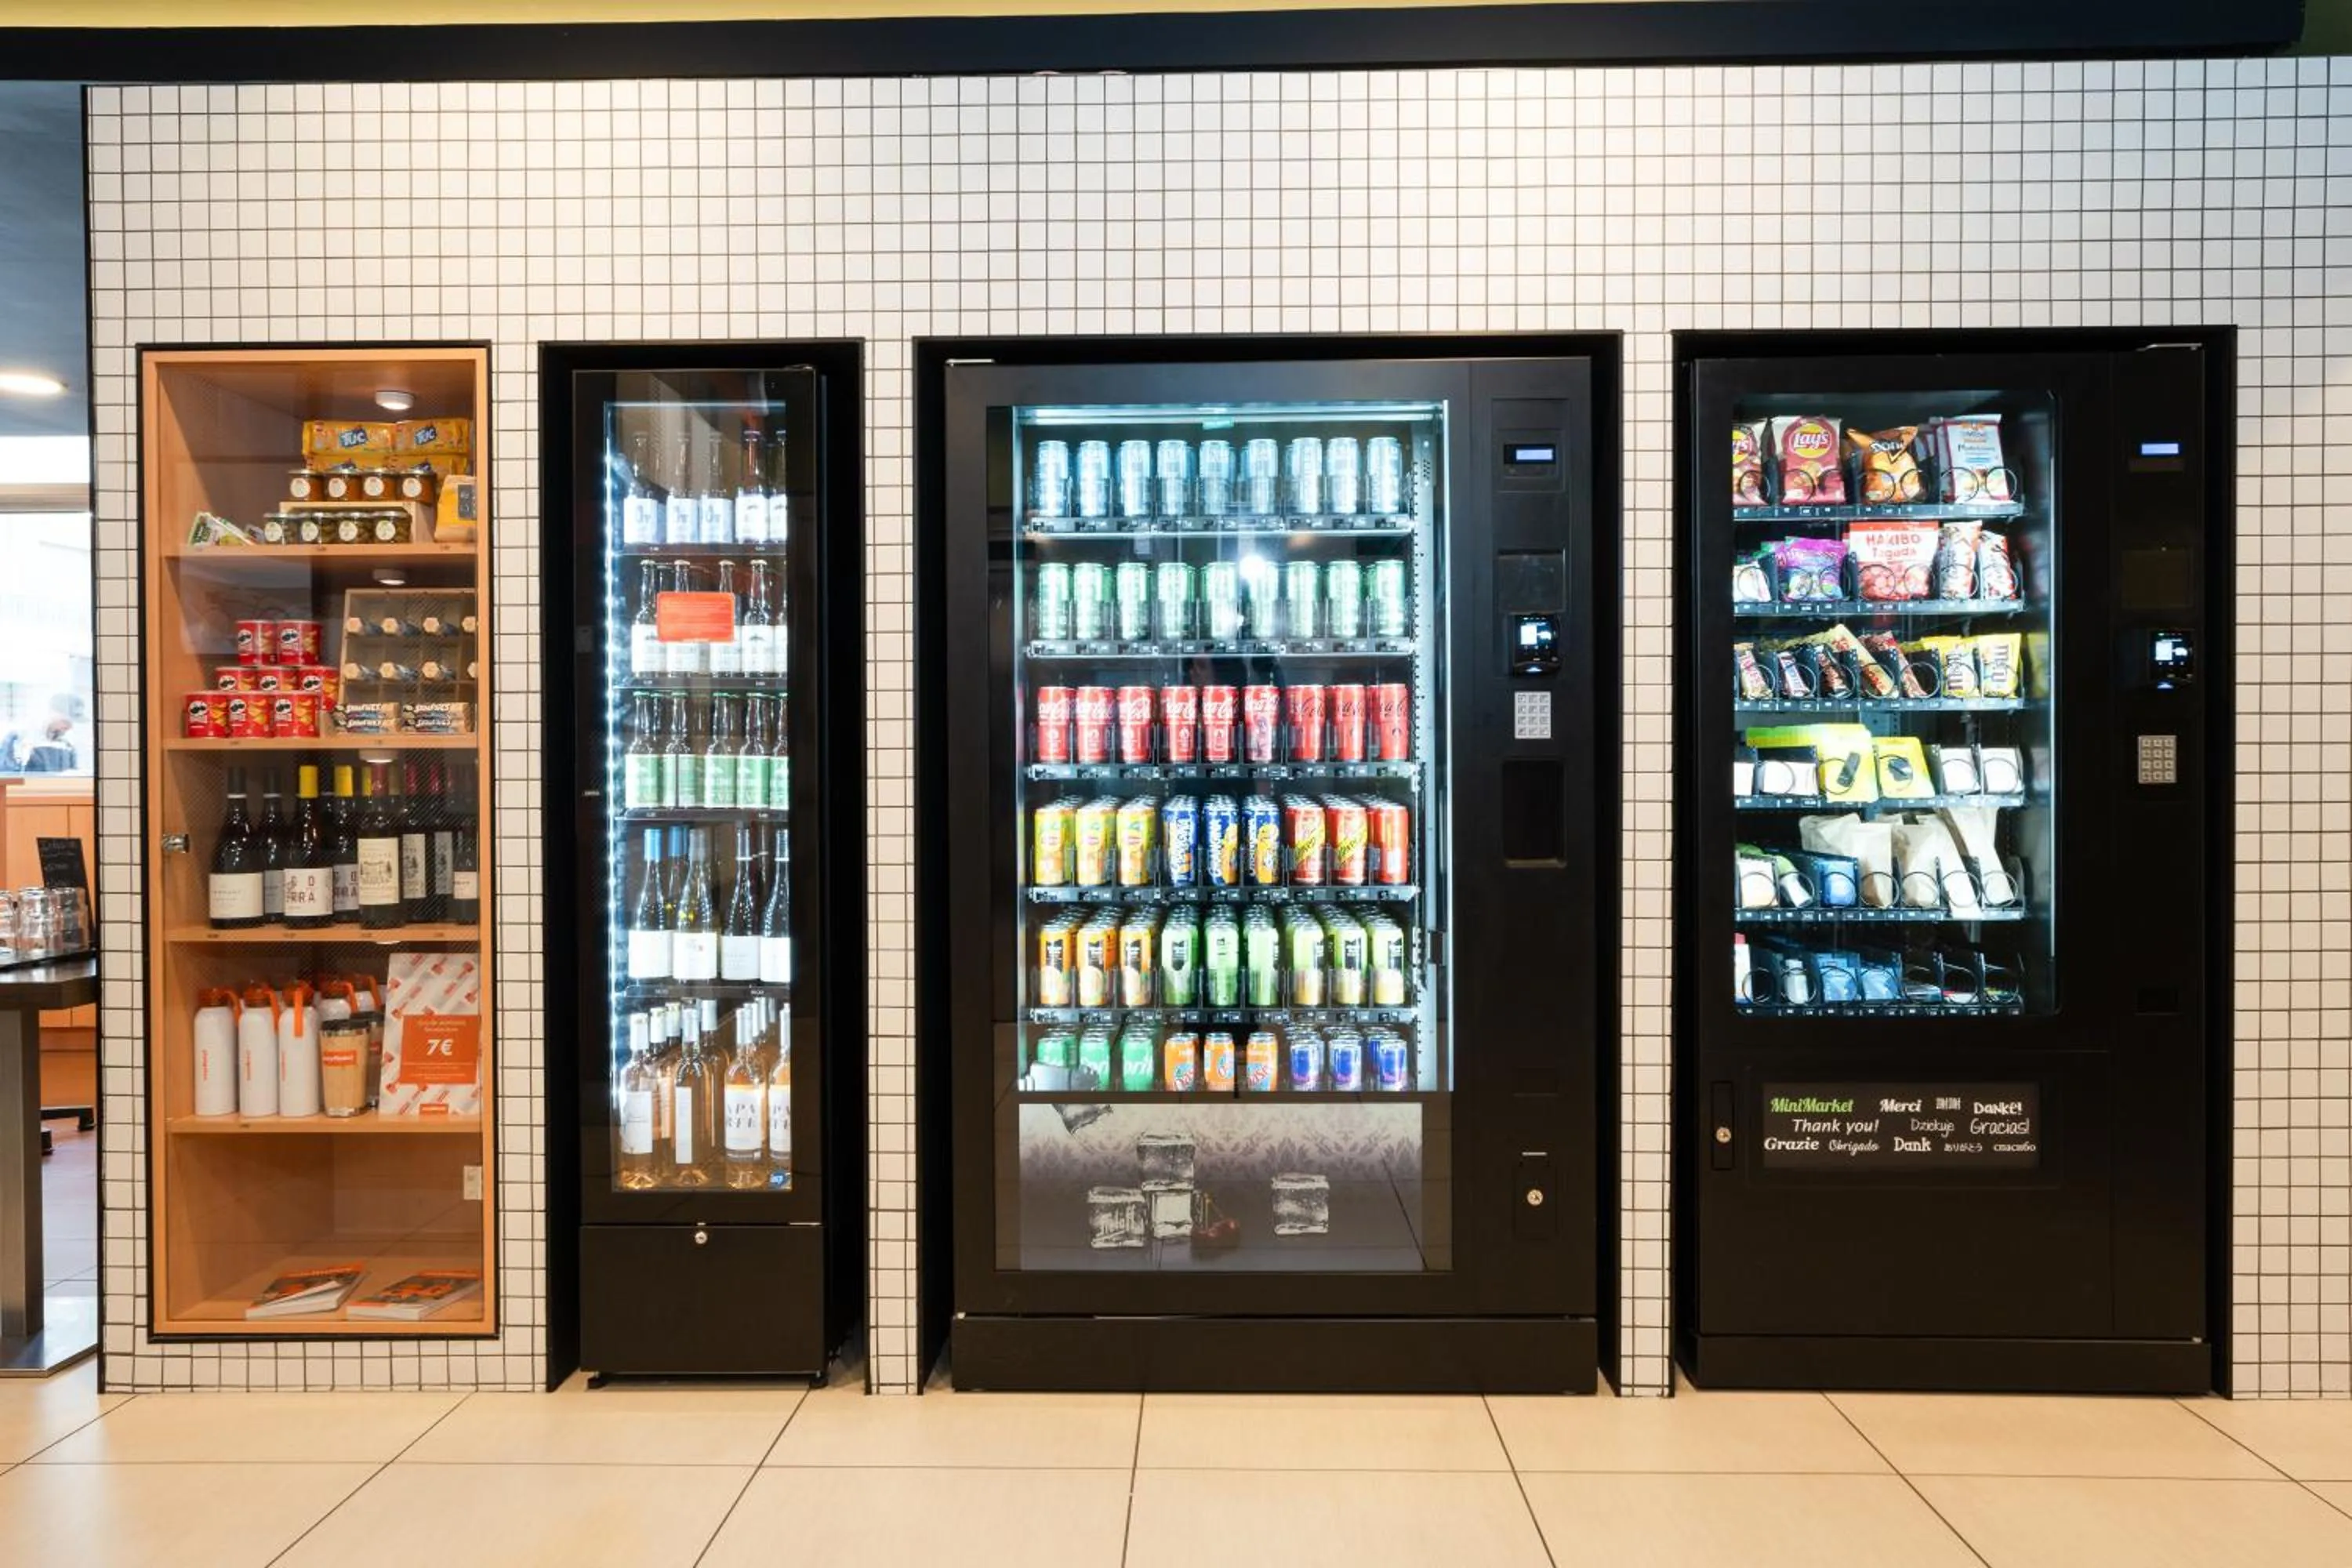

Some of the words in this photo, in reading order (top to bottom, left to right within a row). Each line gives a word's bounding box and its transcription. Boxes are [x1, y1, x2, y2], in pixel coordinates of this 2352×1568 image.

[426, 1039, 453, 1056] 7€
[1770, 1097, 1854, 1112] MiniMarket
[1879, 1099, 1922, 1112] Merci
[1792, 1119, 1842, 1132] Thank
[1846, 1119, 1879, 1135] you!
[1765, 1137, 1820, 1150] Grazie
[1894, 1137, 1932, 1152] Dank
